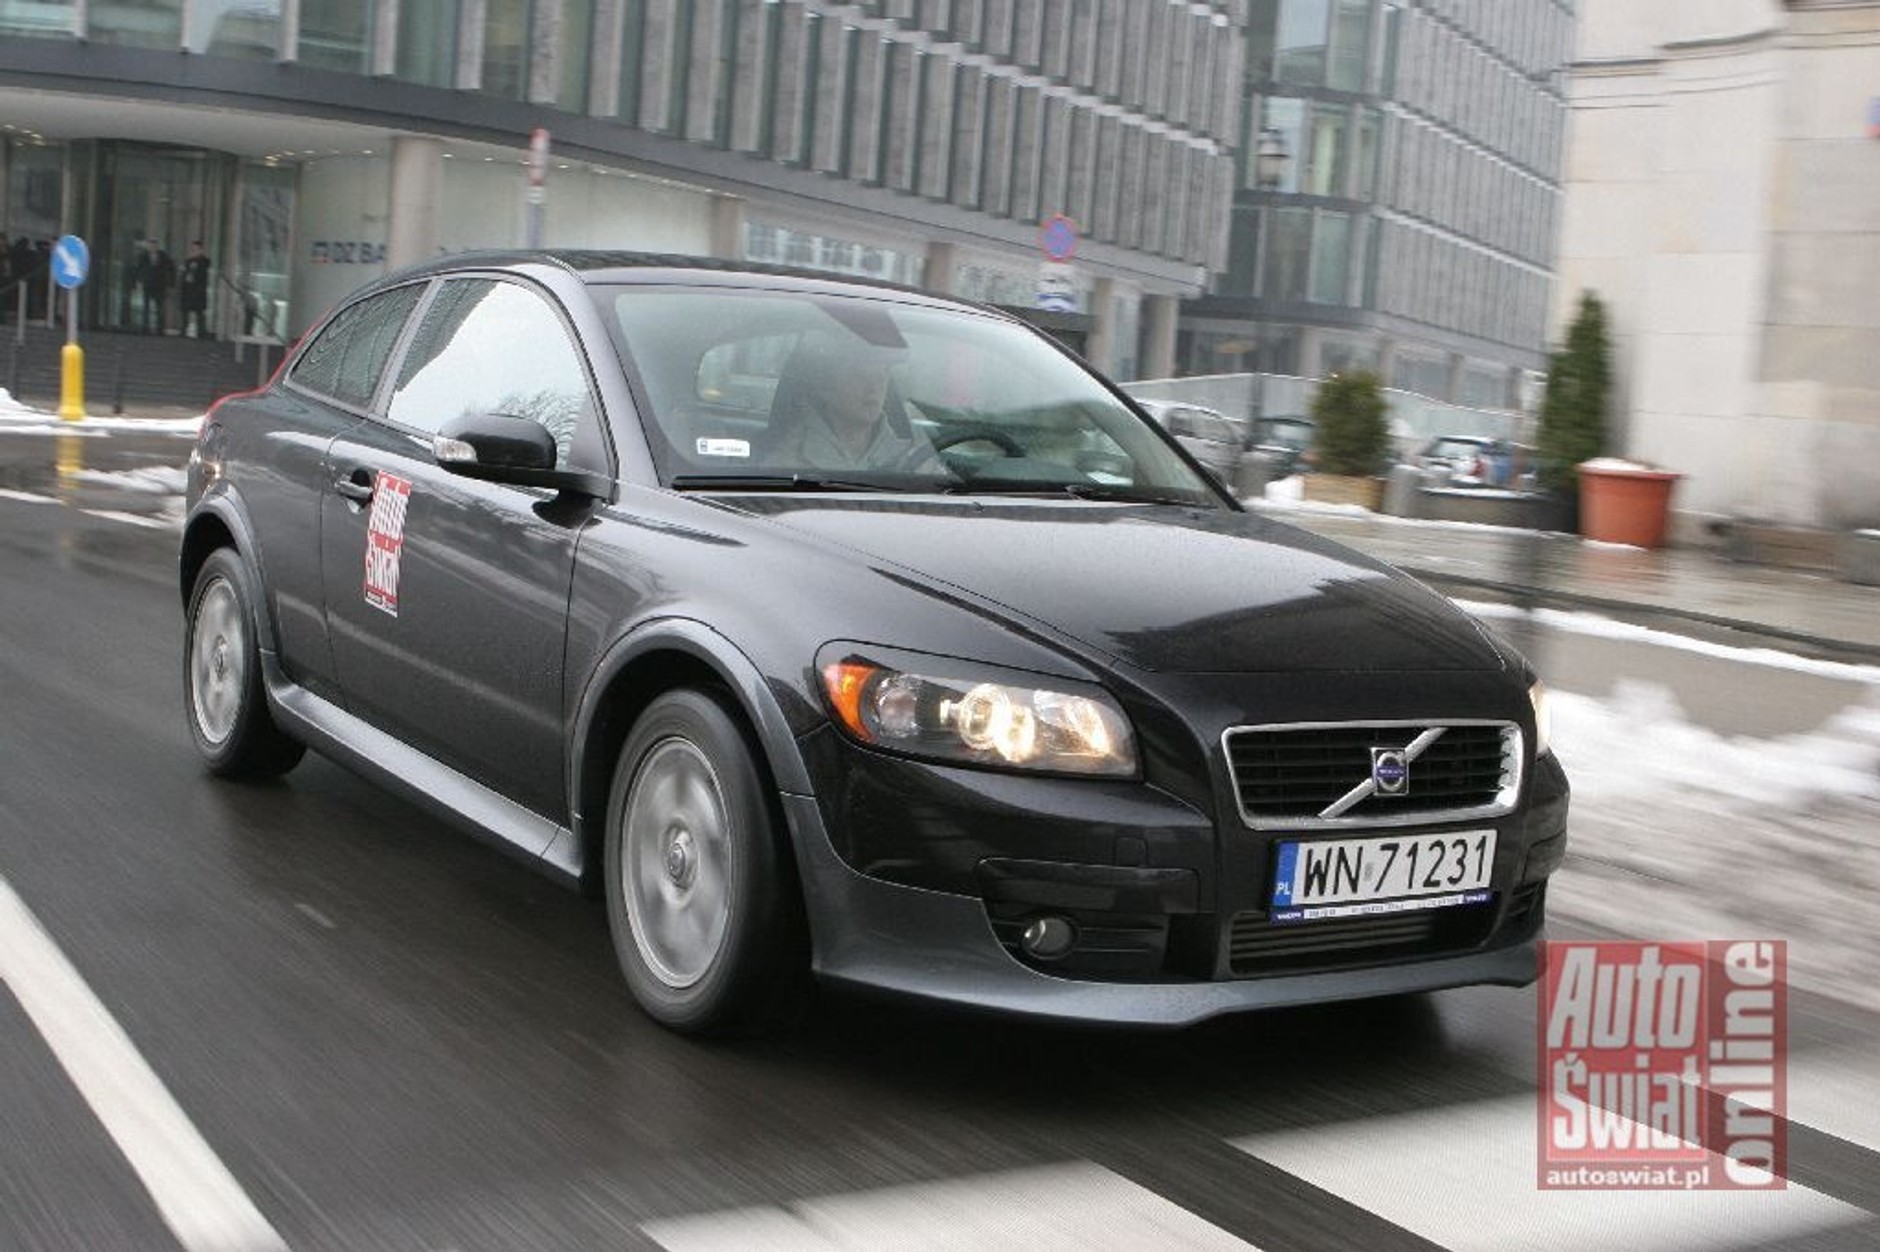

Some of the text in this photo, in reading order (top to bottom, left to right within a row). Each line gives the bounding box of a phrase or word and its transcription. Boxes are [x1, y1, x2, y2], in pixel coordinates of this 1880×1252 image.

[359, 241, 388, 264] BA
[1303, 835, 1487, 897] WN 71231
[1275, 883, 1292, 896] PL
